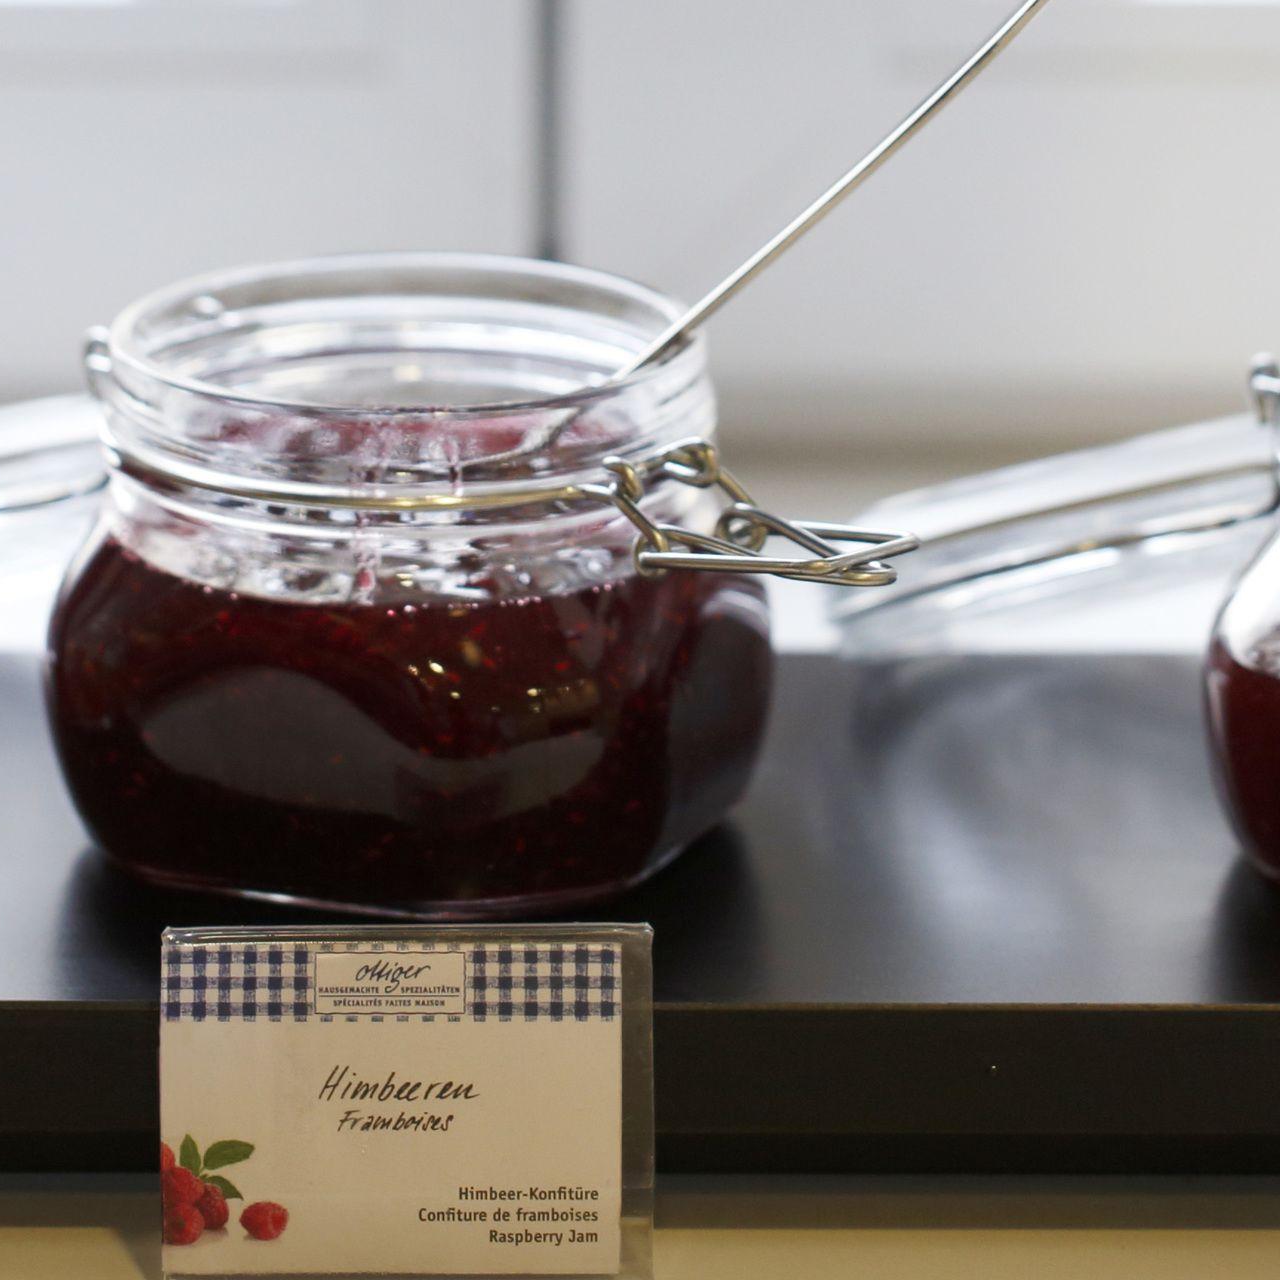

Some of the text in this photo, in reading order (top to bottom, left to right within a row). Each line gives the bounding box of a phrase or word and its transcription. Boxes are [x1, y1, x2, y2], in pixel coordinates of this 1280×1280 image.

[318, 985, 460, 994] HAUSGEMACHTE SPEZIALITÄTEN
[319, 1065, 479, 1101] Himbeeren
[338, 1110, 454, 1131] Framboises
[459, 1186, 598, 1200] Himbeer-Konfitüre
[419, 1208, 598, 1221] Confiture de framboises
[490, 1229, 597, 1246] Raspberry Jam
